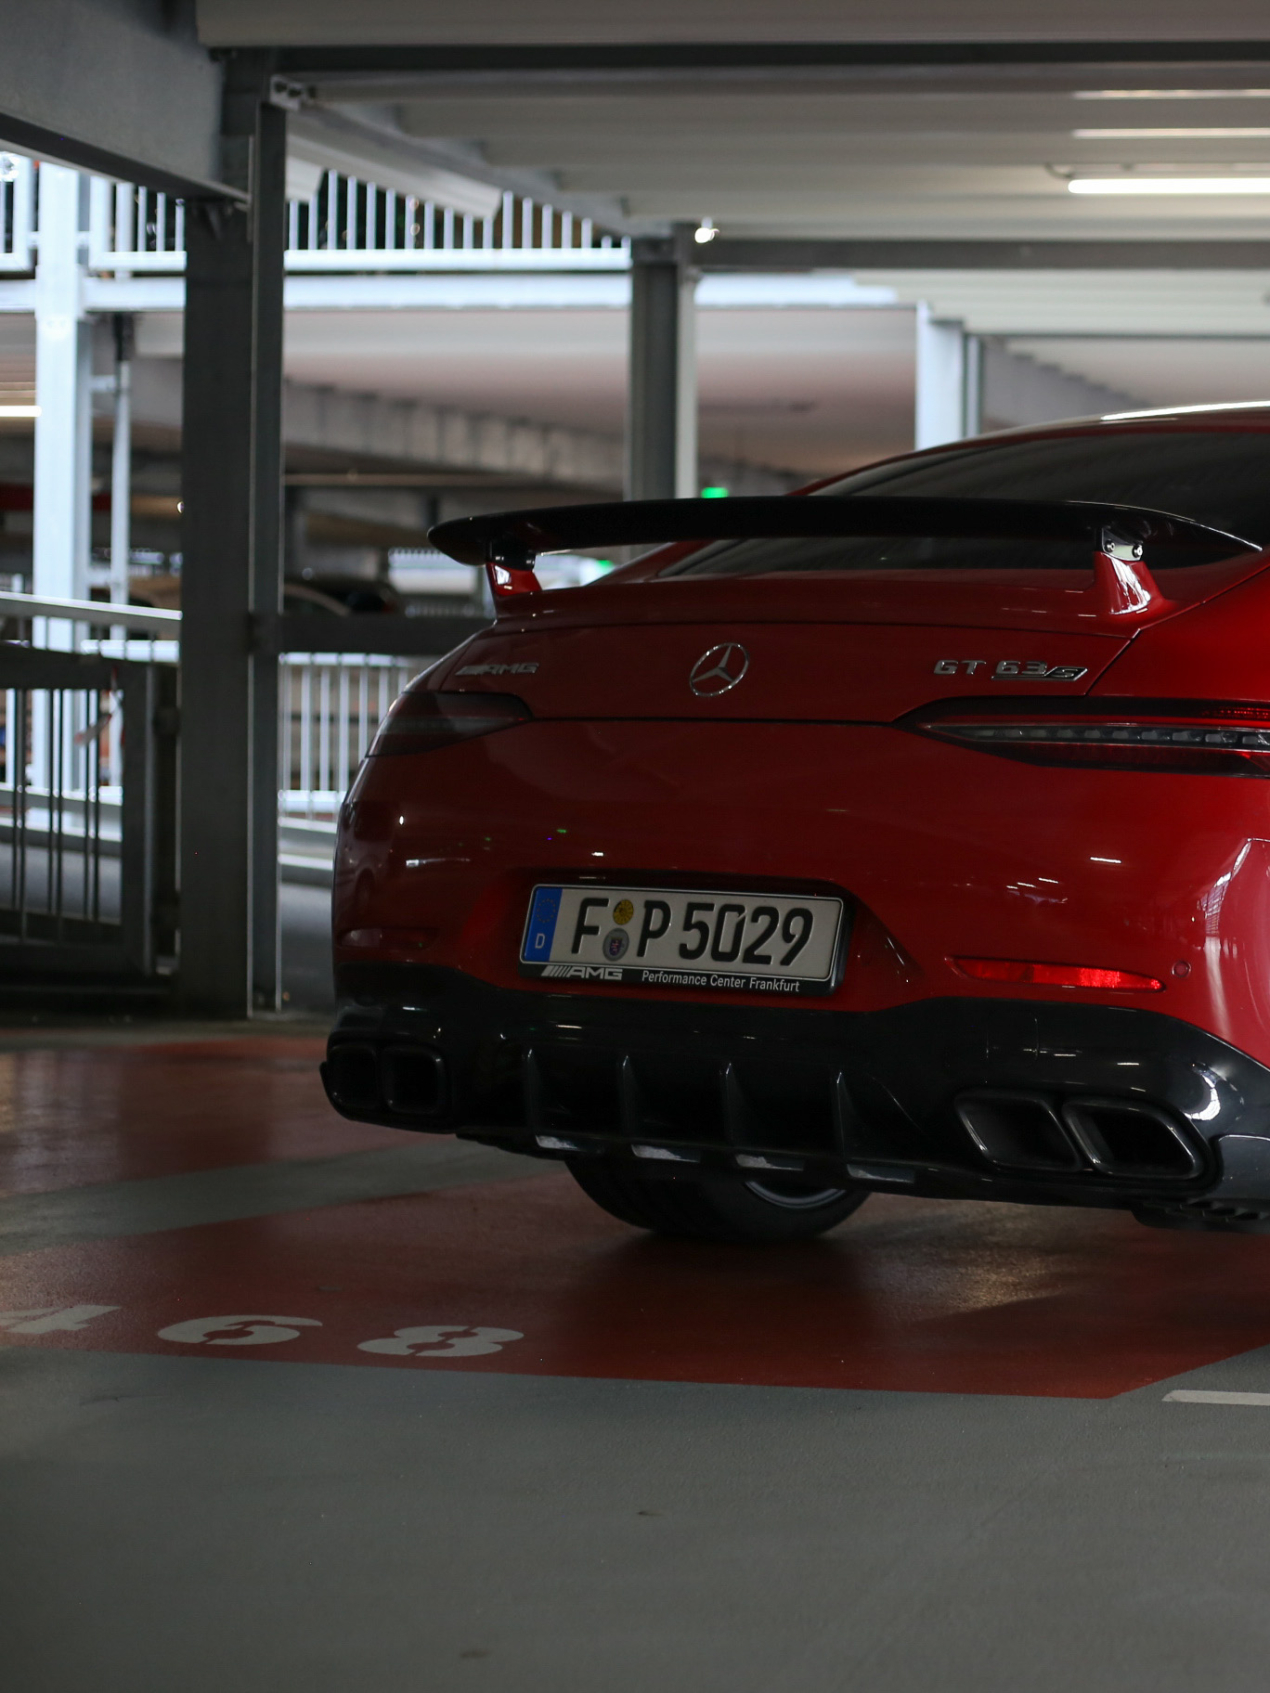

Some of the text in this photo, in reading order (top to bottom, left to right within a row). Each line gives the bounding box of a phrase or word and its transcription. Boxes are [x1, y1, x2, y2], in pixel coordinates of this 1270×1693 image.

[933, 659, 987, 675] GT
[534, 932, 546, 949] D
[571, 897, 814, 967] F P 5029
[566, 965, 800, 992] AMG Performance Center Frankfurt
